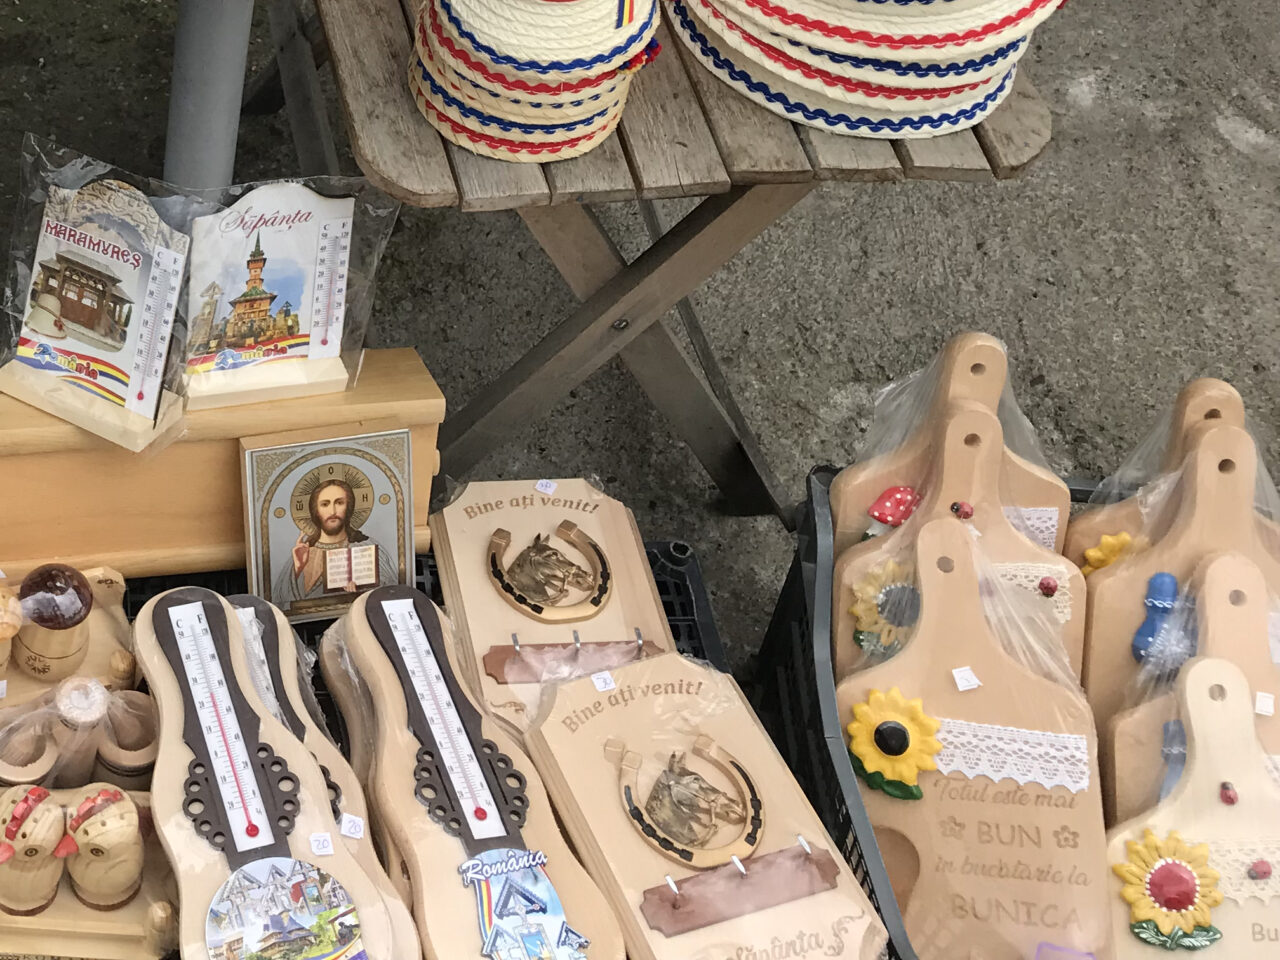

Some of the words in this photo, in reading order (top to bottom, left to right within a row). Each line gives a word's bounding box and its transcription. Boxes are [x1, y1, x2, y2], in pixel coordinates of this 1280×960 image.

[463, 498, 504, 520] Bine
[509, 494, 535, 510] ați
[541, 494, 600, 515] venit!
[561, 700, 605, 734] Bine
[607, 689, 638, 708] ați
[640, 680, 703, 697] venit!
[1034, 793, 1078, 809] mai
[977, 821, 1042, 848] BUN
[458, 850, 548, 887] România
[951, 893, 1082, 932] BUNICA
